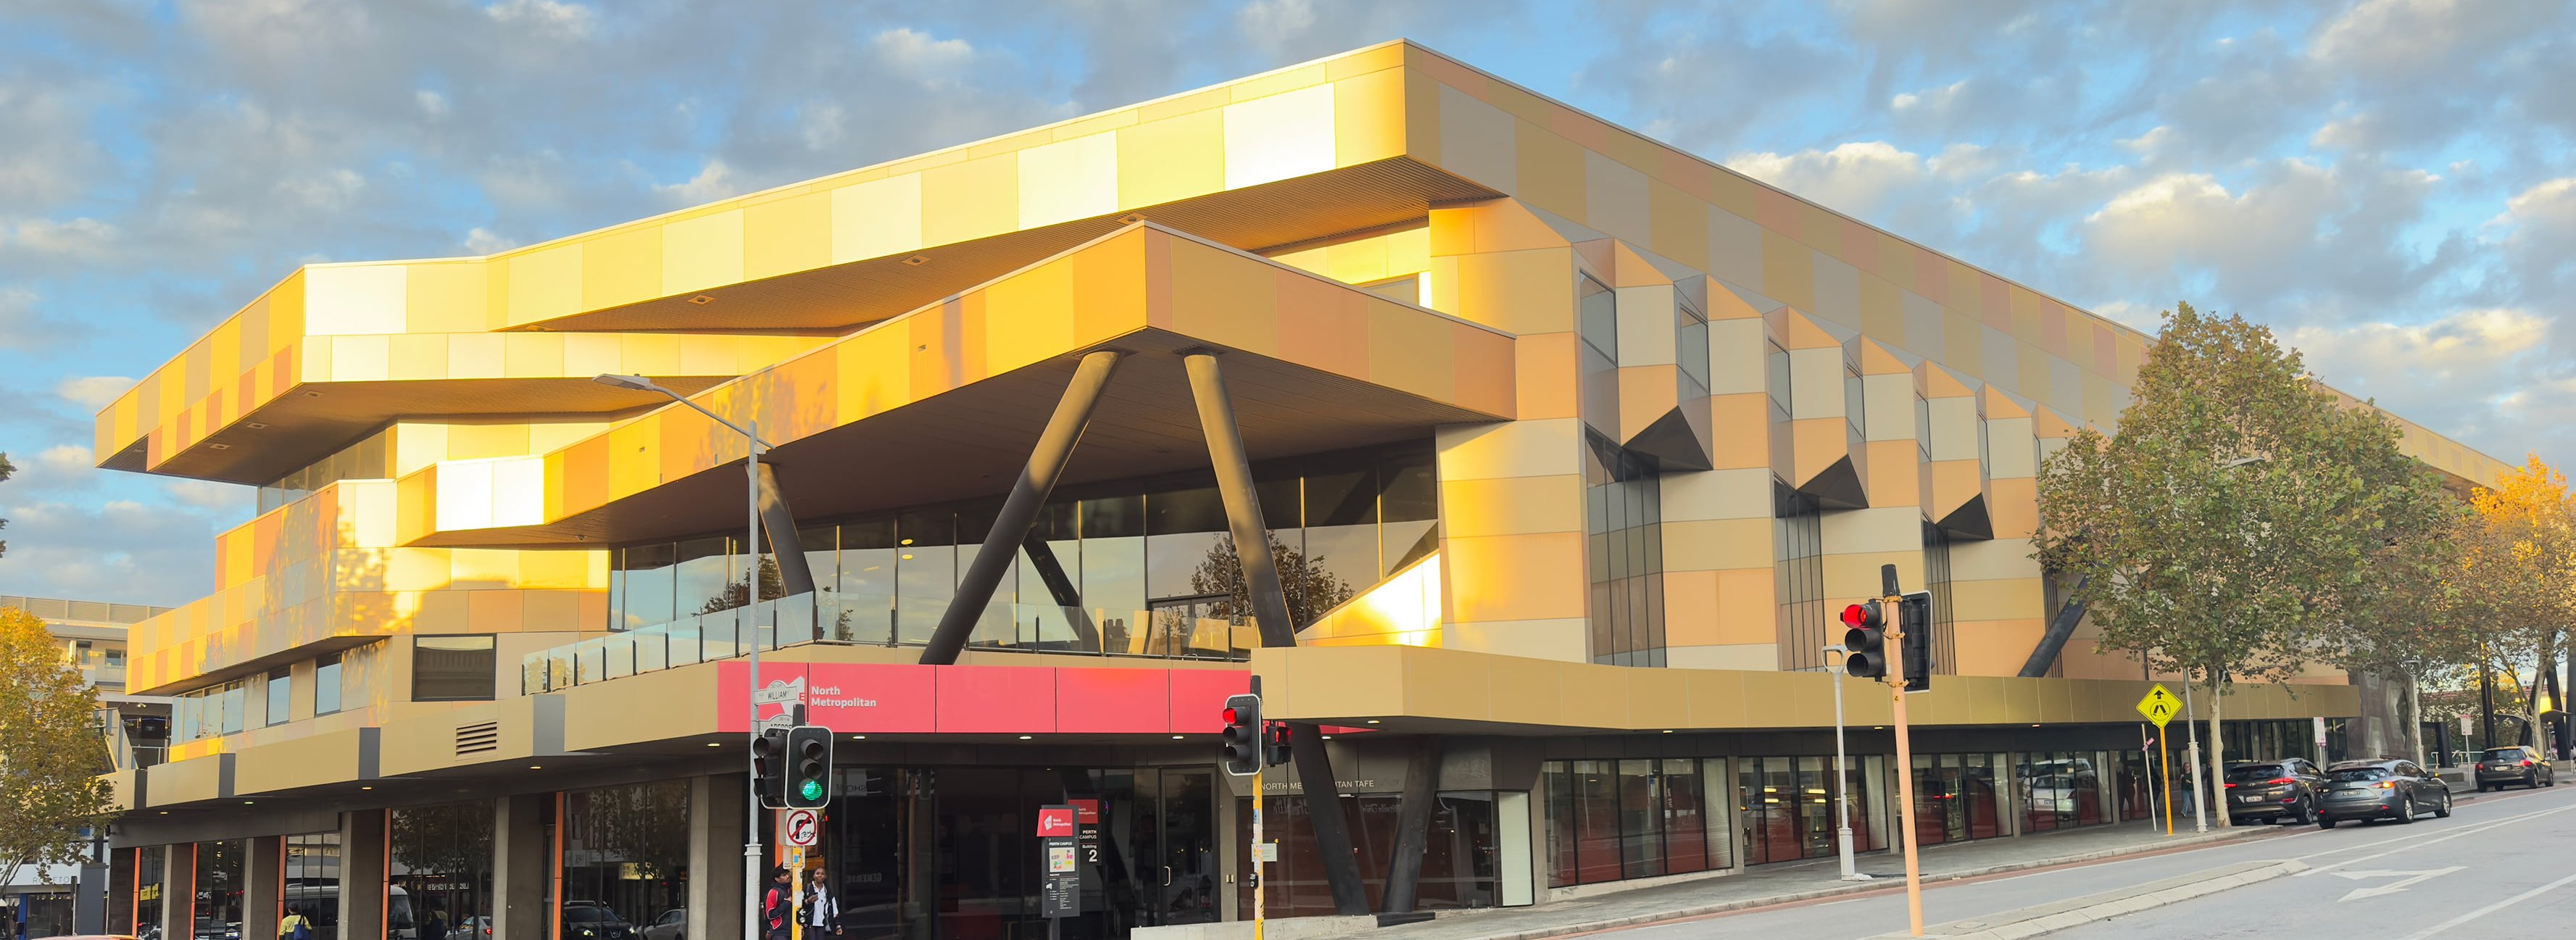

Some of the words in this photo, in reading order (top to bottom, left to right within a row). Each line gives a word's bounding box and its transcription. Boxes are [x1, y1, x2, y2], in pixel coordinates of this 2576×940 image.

[768, 691, 787, 700] WILLIAM
[812, 686, 841, 695] North
[812, 697, 876, 709] Metropolitan
[1089, 849, 1097, 862] 2
